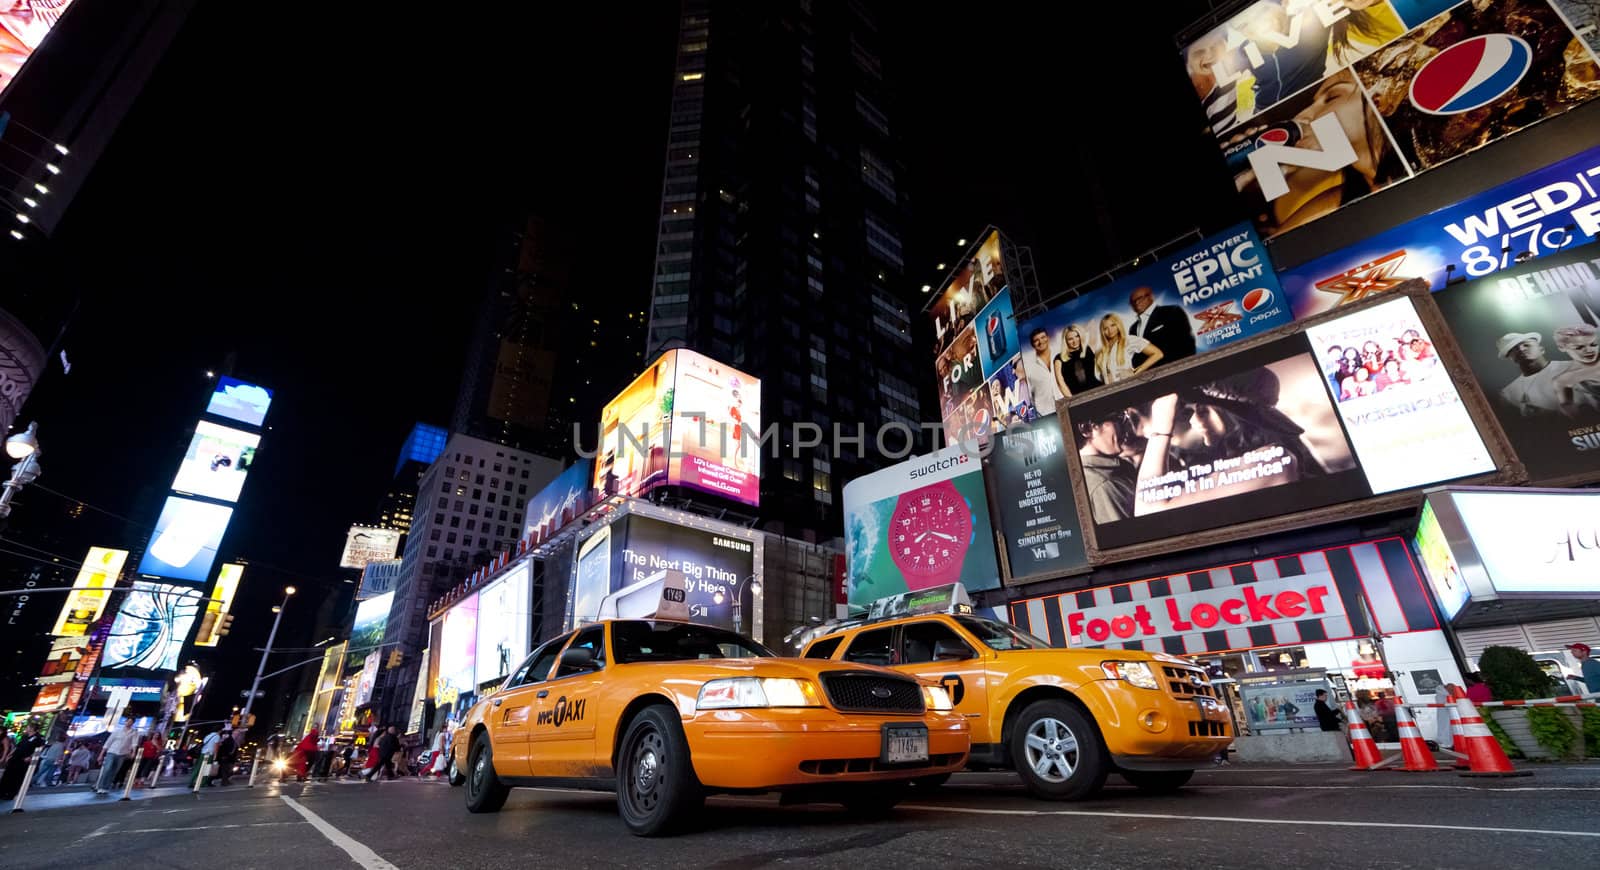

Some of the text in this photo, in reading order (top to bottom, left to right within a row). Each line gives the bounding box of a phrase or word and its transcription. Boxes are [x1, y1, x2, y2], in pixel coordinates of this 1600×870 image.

[1171, 231, 1249, 271] CATCH EVERY
[1173, 241, 1260, 296] EPIC
[1182, 264, 1263, 306] MOMENT
[1250, 306, 1282, 326] pepsi
[910, 456, 960, 480] swatch
[1140, 446, 1285, 489] Including The New Single
[1019, 492, 1057, 508] UNDERWOOD
[1025, 486, 1047, 498] CARRIE
[713, 536, 751, 553] SAMSUNG
[1017, 532, 1049, 547] SUNDAYS
[622, 549, 647, 566] The
[649, 554, 681, 571] Next
[682, 560, 703, 579] Big
[705, 564, 738, 585] Thing
[633, 567, 646, 581] Is
[698, 578, 727, 595] Here
[8, 572, 41, 625] NOOTEL
[1068, 585, 1329, 643] Foot Locker
